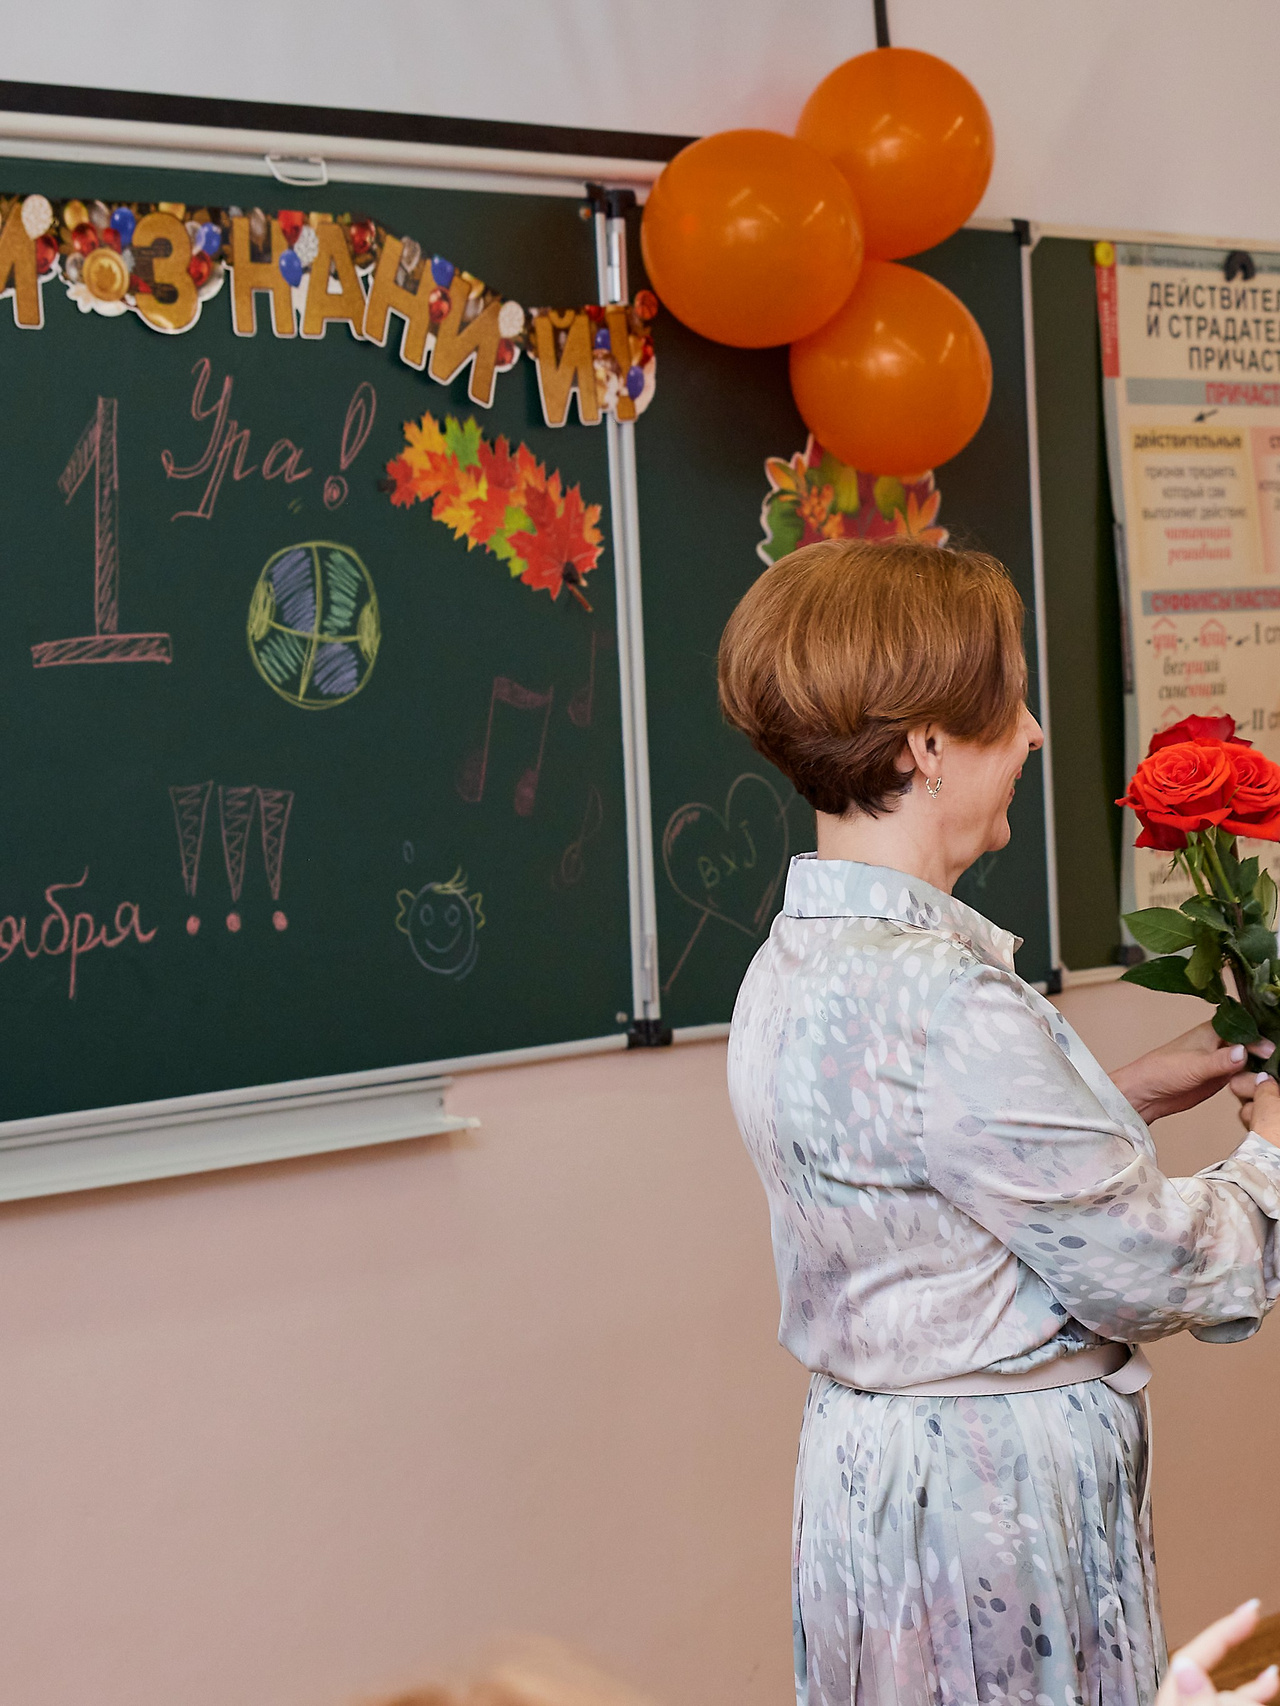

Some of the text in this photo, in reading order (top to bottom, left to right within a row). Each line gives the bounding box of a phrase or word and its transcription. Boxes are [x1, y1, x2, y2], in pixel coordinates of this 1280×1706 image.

[1147, 315, 1161, 338] И
[1135, 432, 1241, 449] действительные
[1151, 592, 1231, 613] СУФФИКСЫ
